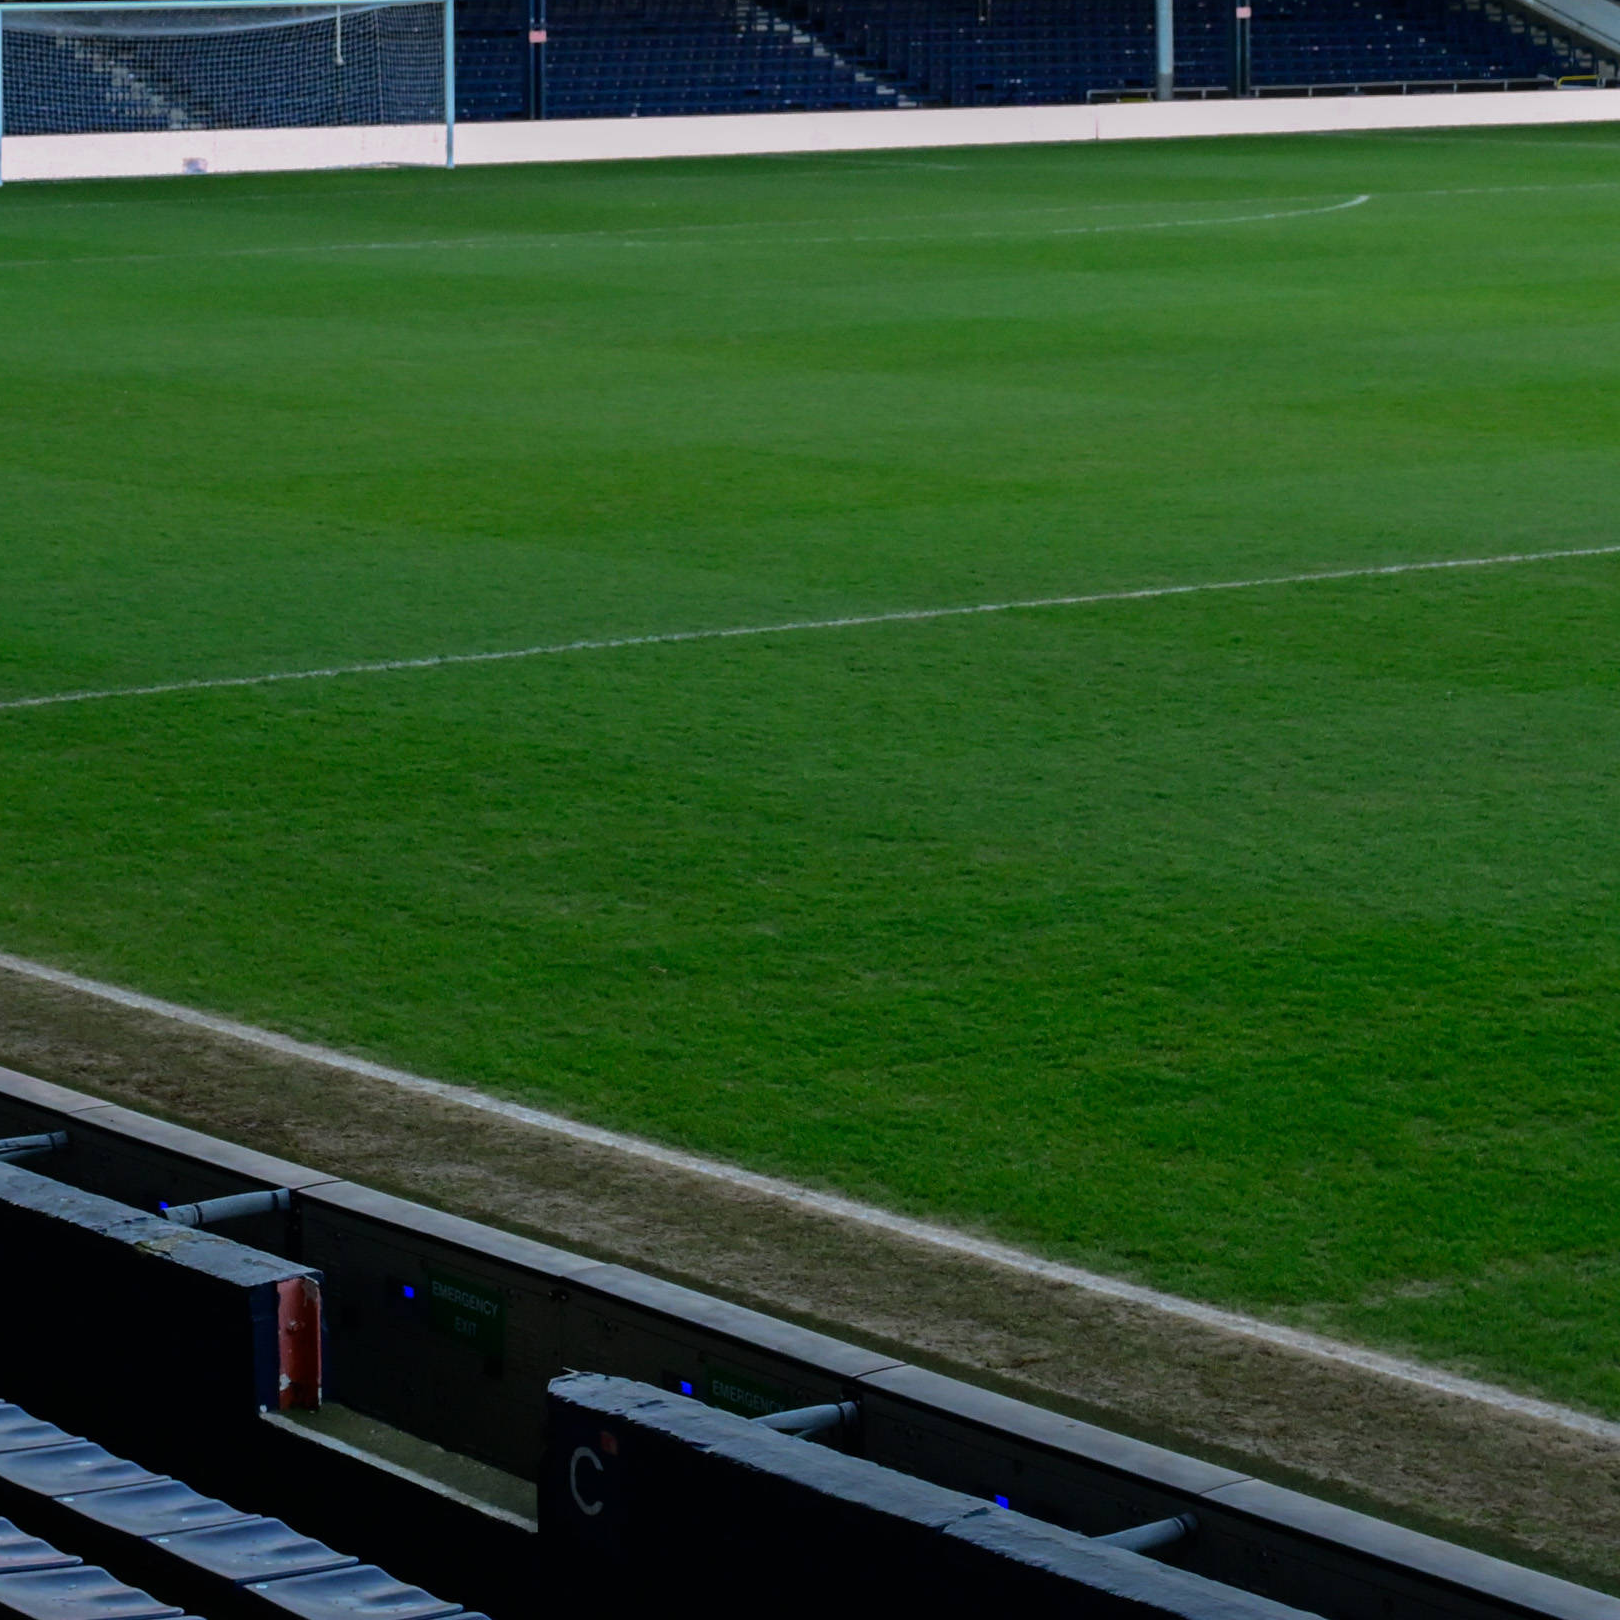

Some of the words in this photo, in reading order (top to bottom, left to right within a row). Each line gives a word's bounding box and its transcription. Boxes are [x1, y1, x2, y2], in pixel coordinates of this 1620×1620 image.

[431, 1280, 499, 1318] EMERGENCY
[453, 1315, 479, 1338] EXIT
[569, 1446, 604, 1516] C
